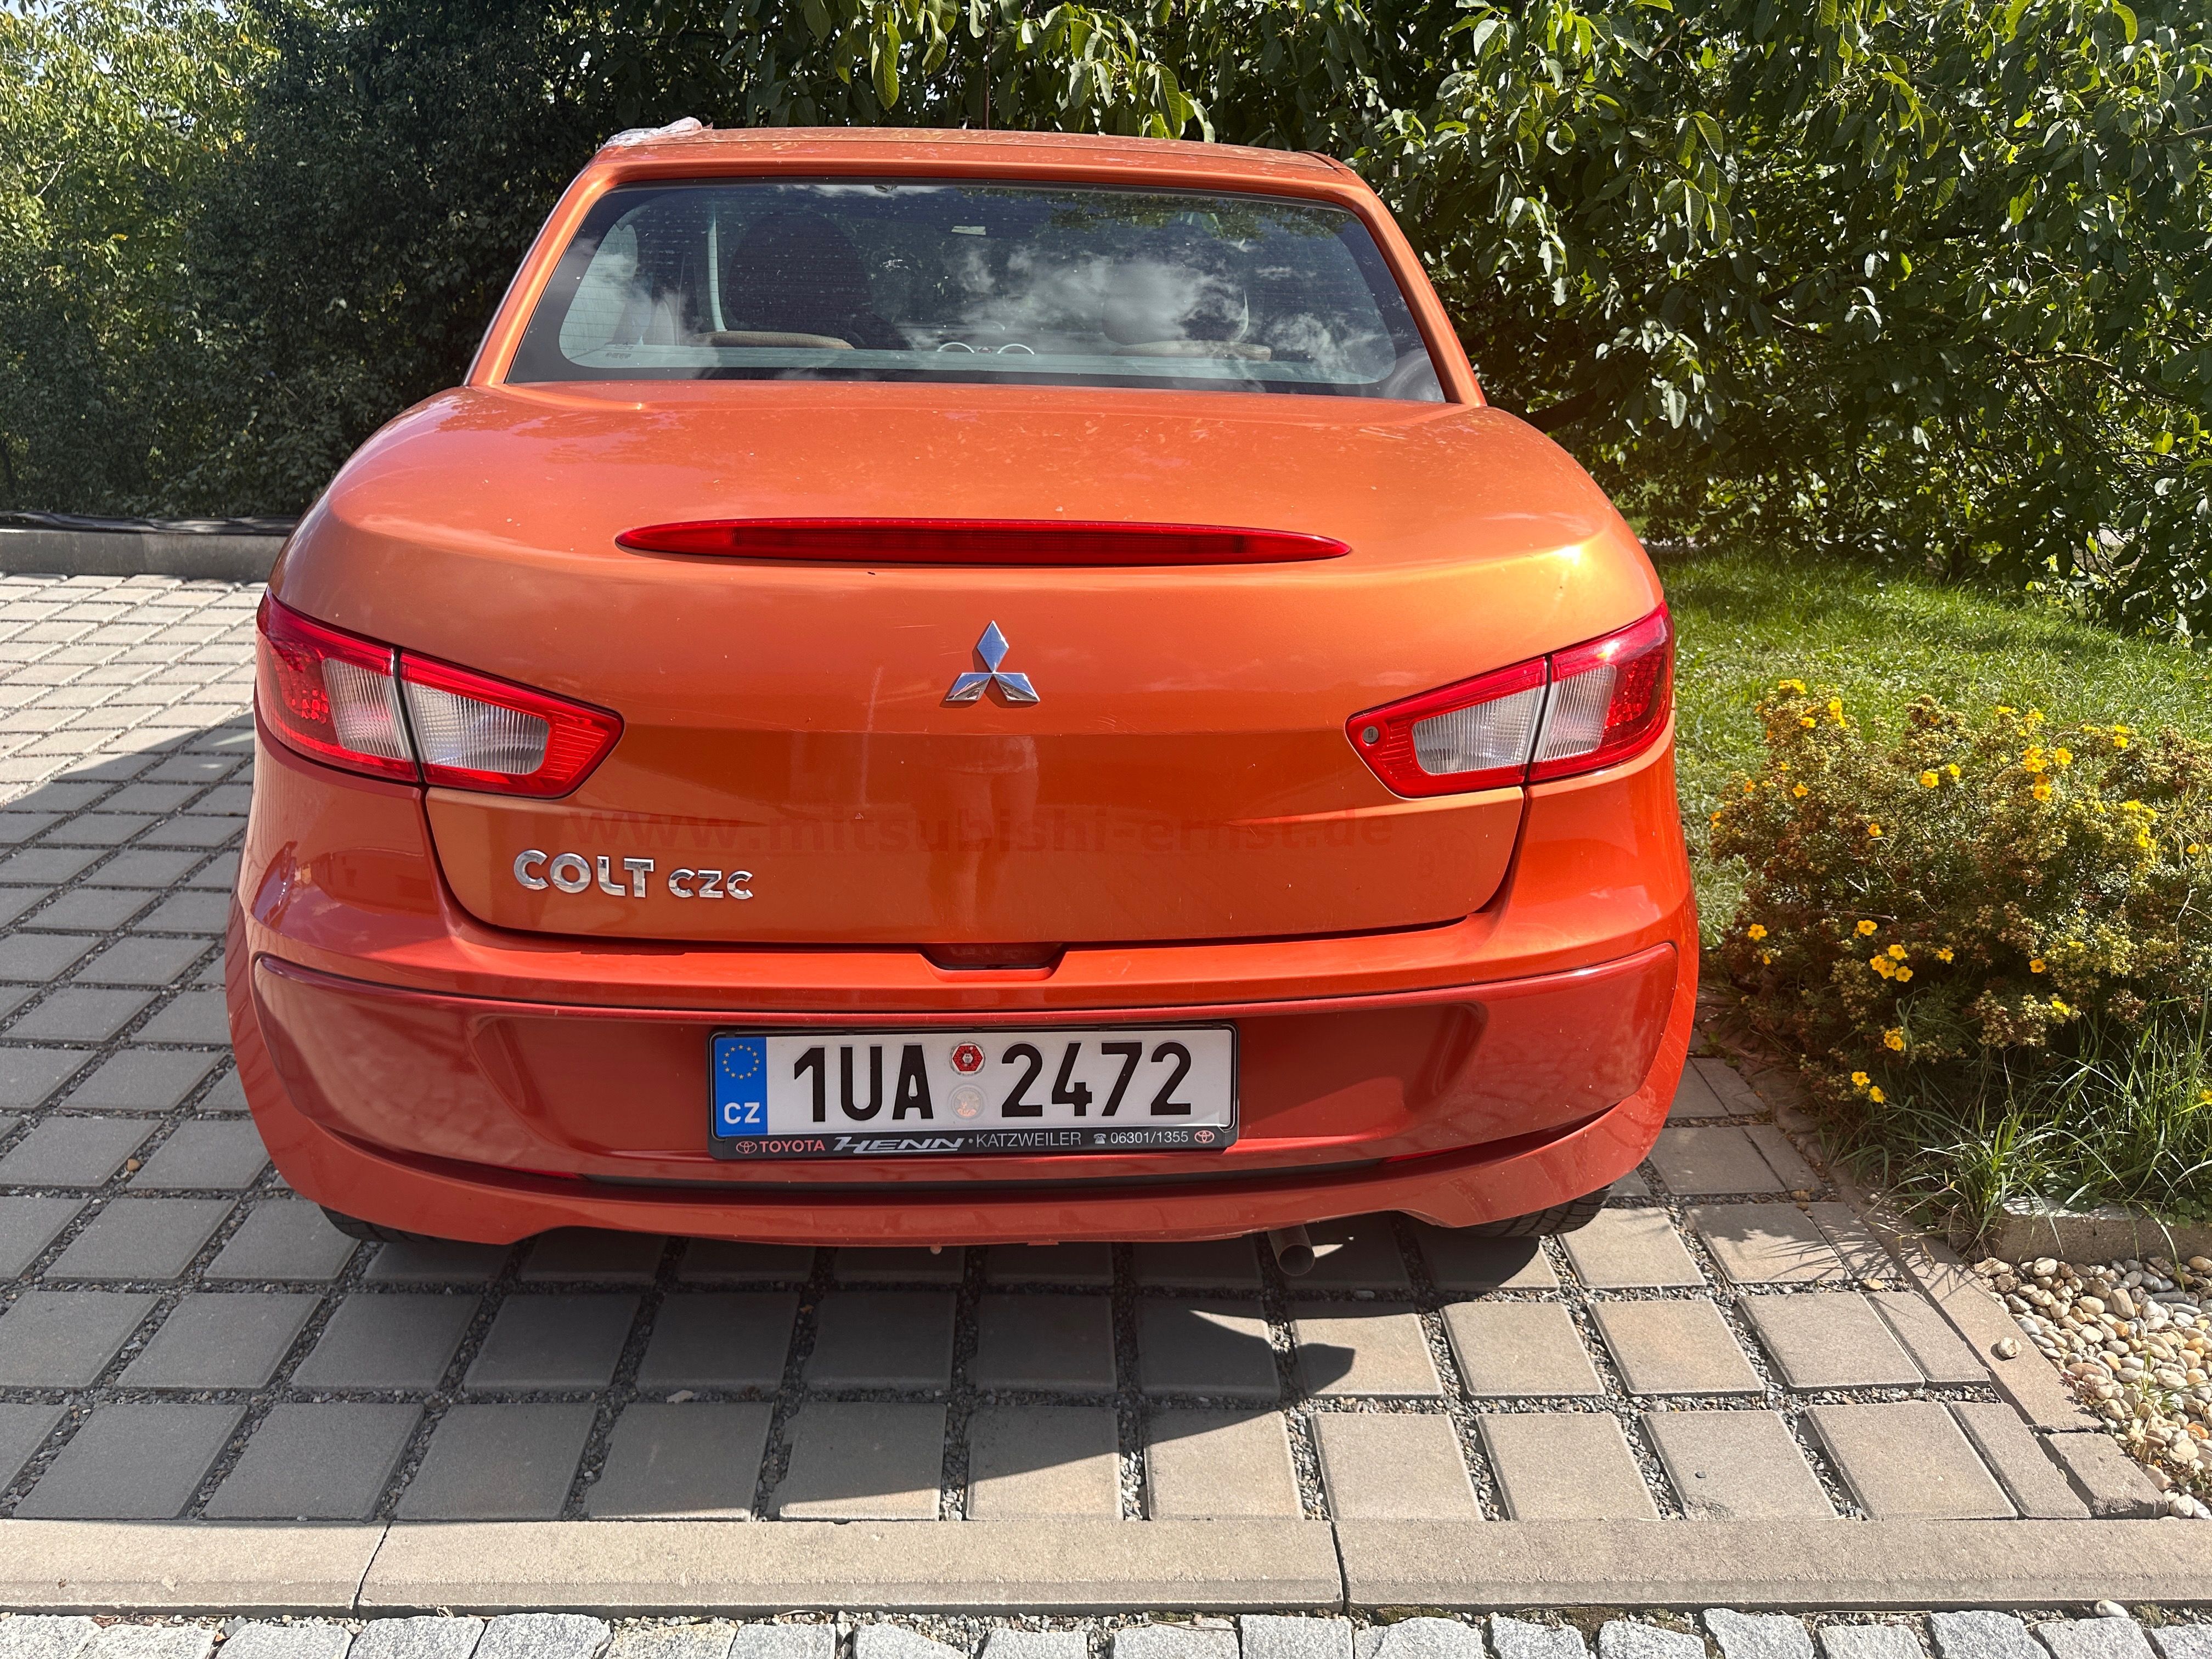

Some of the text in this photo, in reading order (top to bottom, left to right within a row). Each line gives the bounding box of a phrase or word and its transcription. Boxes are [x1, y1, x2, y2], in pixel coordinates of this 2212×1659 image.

[568, 804, 1392, 851] www.mitsubishi-ernst.de
[513, 849, 754, 900] COLT CZC
[794, 1041, 1192, 1122] 1UA 2472
[724, 1102, 760, 1125] CZ
[759, 1131, 1189, 1154] TOYOTA HENN KATZWEILER 06301/1355
